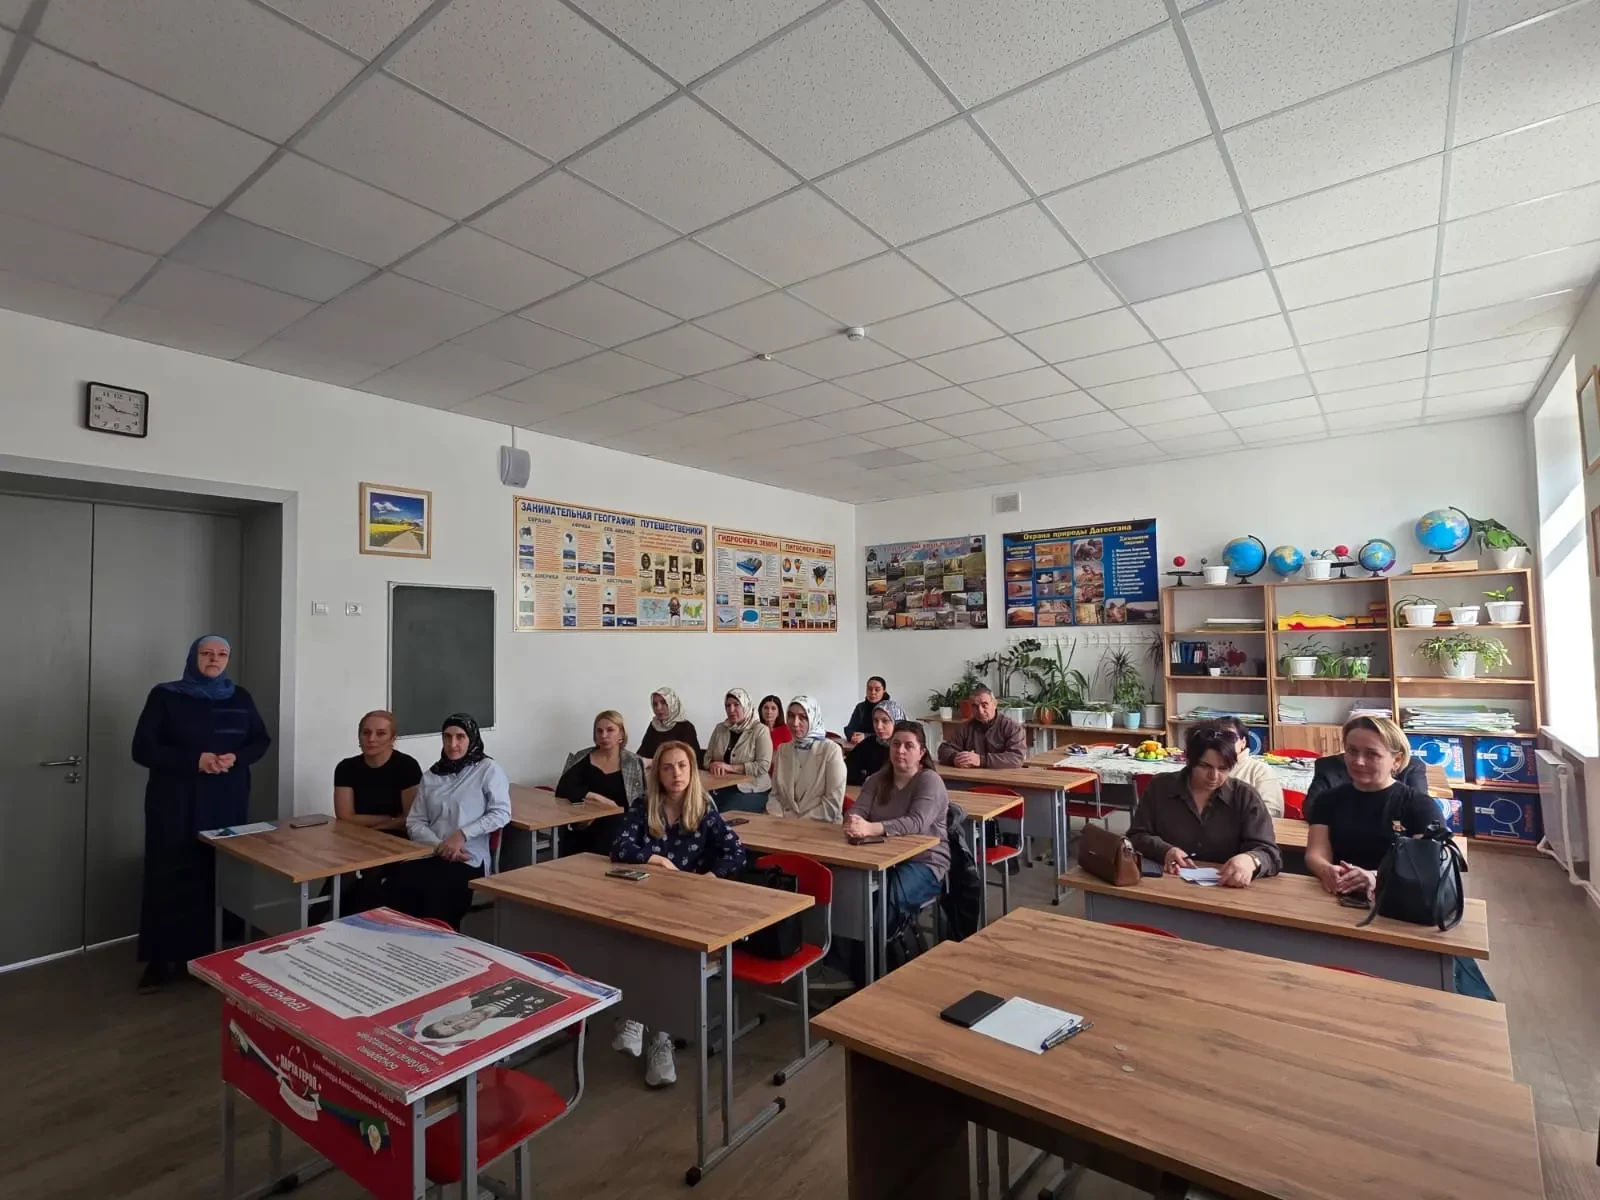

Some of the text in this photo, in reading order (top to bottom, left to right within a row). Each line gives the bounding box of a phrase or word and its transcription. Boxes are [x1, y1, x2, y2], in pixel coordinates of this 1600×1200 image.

[521, 502, 636, 528] ЗАНИМАТЕЛЬНАЯ ГЕОГРАФИЯ
[718, 534, 758, 545] ГИДРОСФЕРА
[1024, 524, 1132, 540] Охрана природы Дагестана
[280, 1054, 299, 1078] ПАРТА
